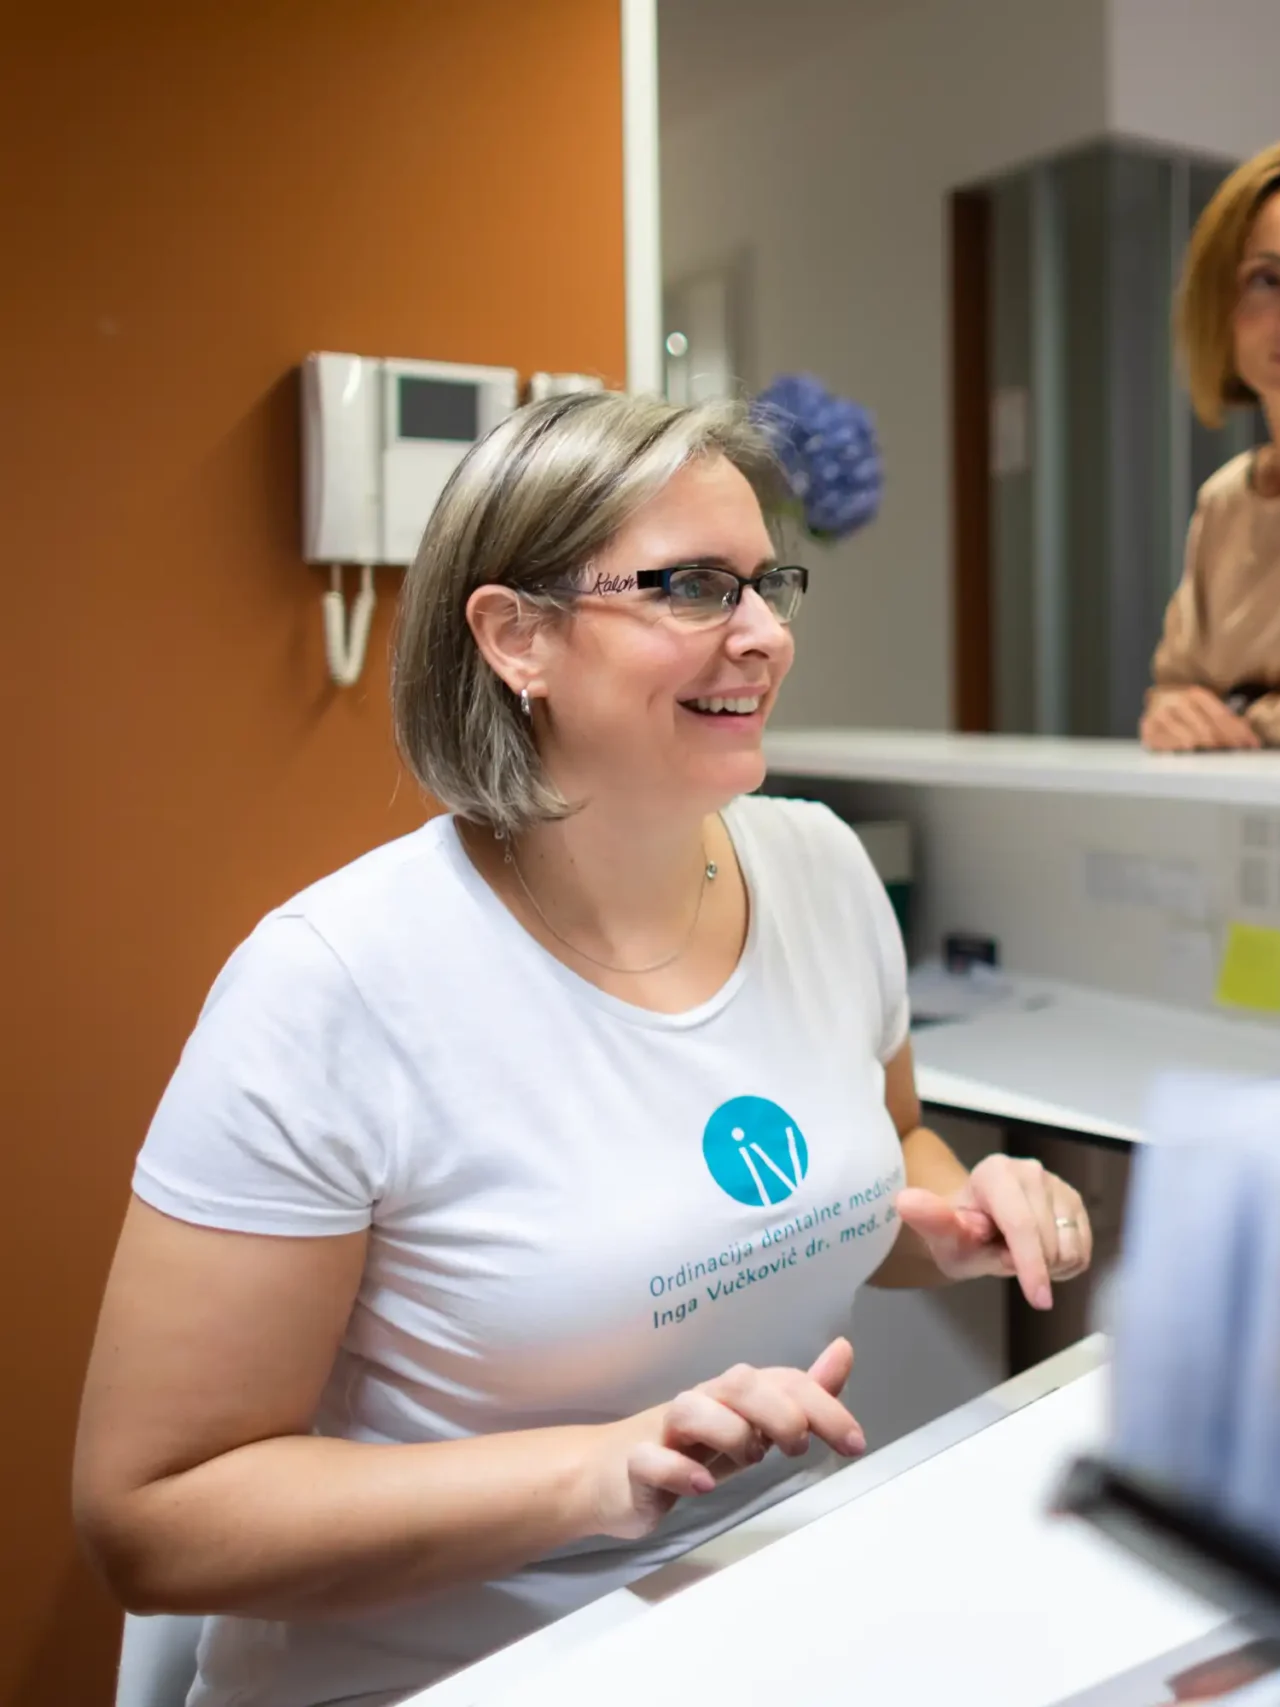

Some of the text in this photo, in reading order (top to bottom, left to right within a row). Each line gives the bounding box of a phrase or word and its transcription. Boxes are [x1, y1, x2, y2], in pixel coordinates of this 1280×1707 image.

[649, 1243, 754, 1297] Ordinacija
[761, 1201, 842, 1249] dentalne
[652, 1297, 698, 1329] Inga
[706, 1247, 799, 1302] Vučković
[805, 1235, 831, 1259] dr.
[840, 1212, 881, 1243] med.
